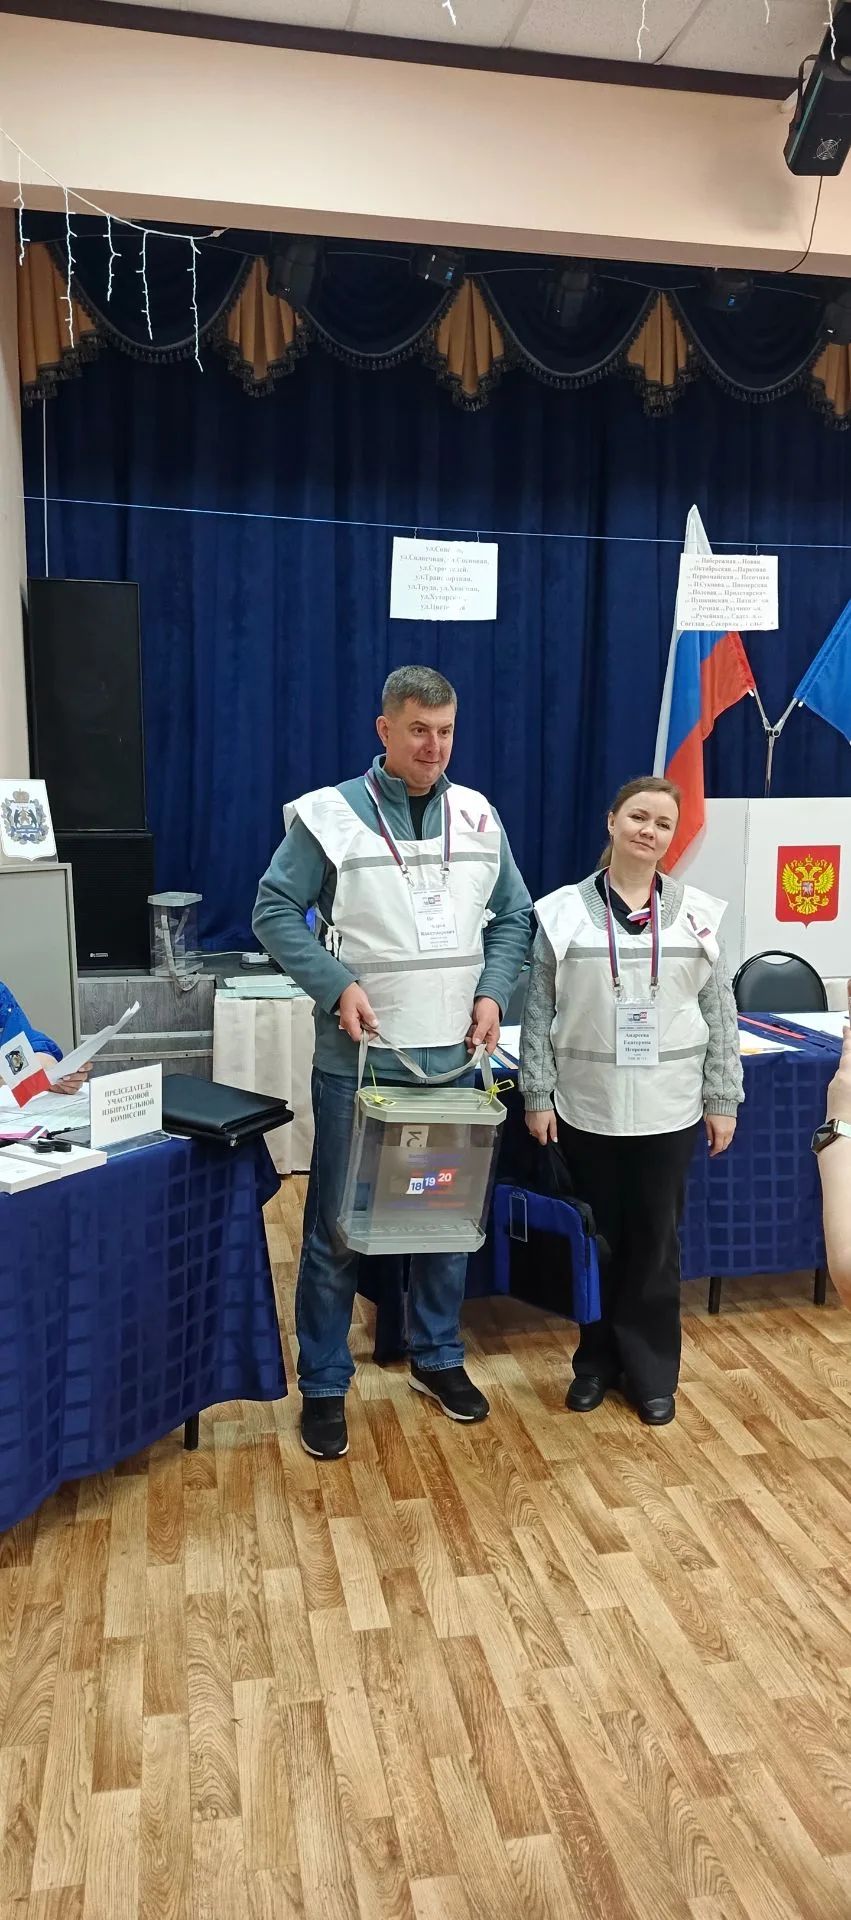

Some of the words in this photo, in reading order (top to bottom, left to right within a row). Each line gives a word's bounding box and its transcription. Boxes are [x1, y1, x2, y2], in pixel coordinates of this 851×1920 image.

[104, 1082, 153, 1098] ПРЕДСЕДАТЕЛЬ
[107, 1090, 150, 1106] УЧАСТКОВОЙ
[101, 1098, 155, 1116] ИЗБИРАТЕЛЬНОЙ
[110, 1109, 147, 1123] КОМИССИИ
[411, 1182, 422, 1191] 18
[425, 1177, 436, 1187] 19
[437, 1172, 453, 1182] 20
